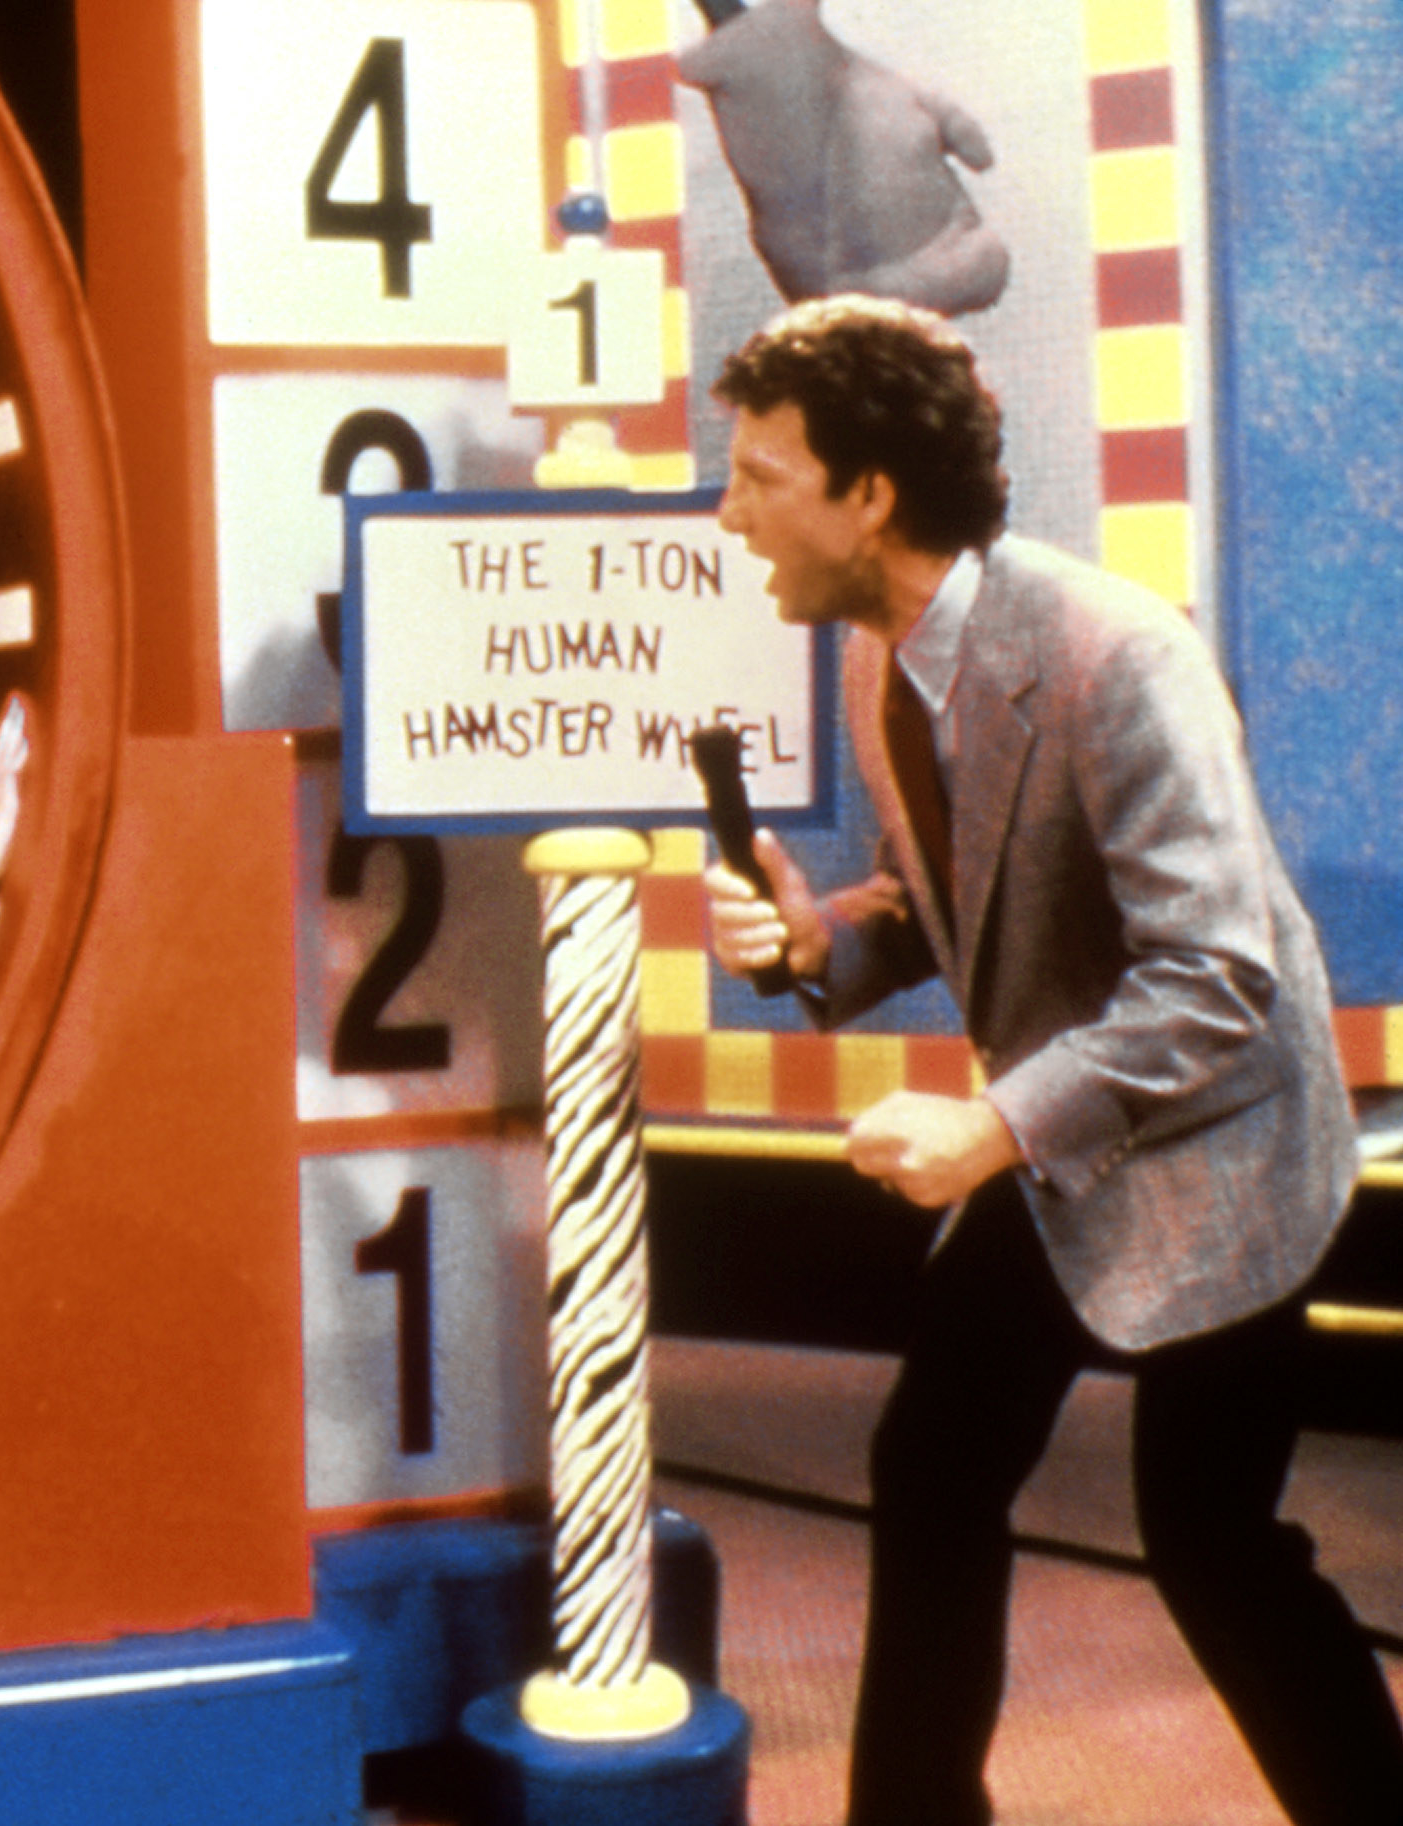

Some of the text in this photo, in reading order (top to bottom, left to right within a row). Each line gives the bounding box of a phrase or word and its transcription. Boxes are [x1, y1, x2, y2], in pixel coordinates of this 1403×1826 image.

[305, 37, 433, 300] 4
[548, 280, 599, 387] 1
[450, 539, 724, 597] THE 1-TON
[484, 620, 663, 675] HUMAN
[403, 697, 614, 761] HAMSTER
[326, 829, 451, 1076] 2
[355, 1186, 435, 1457] 1
